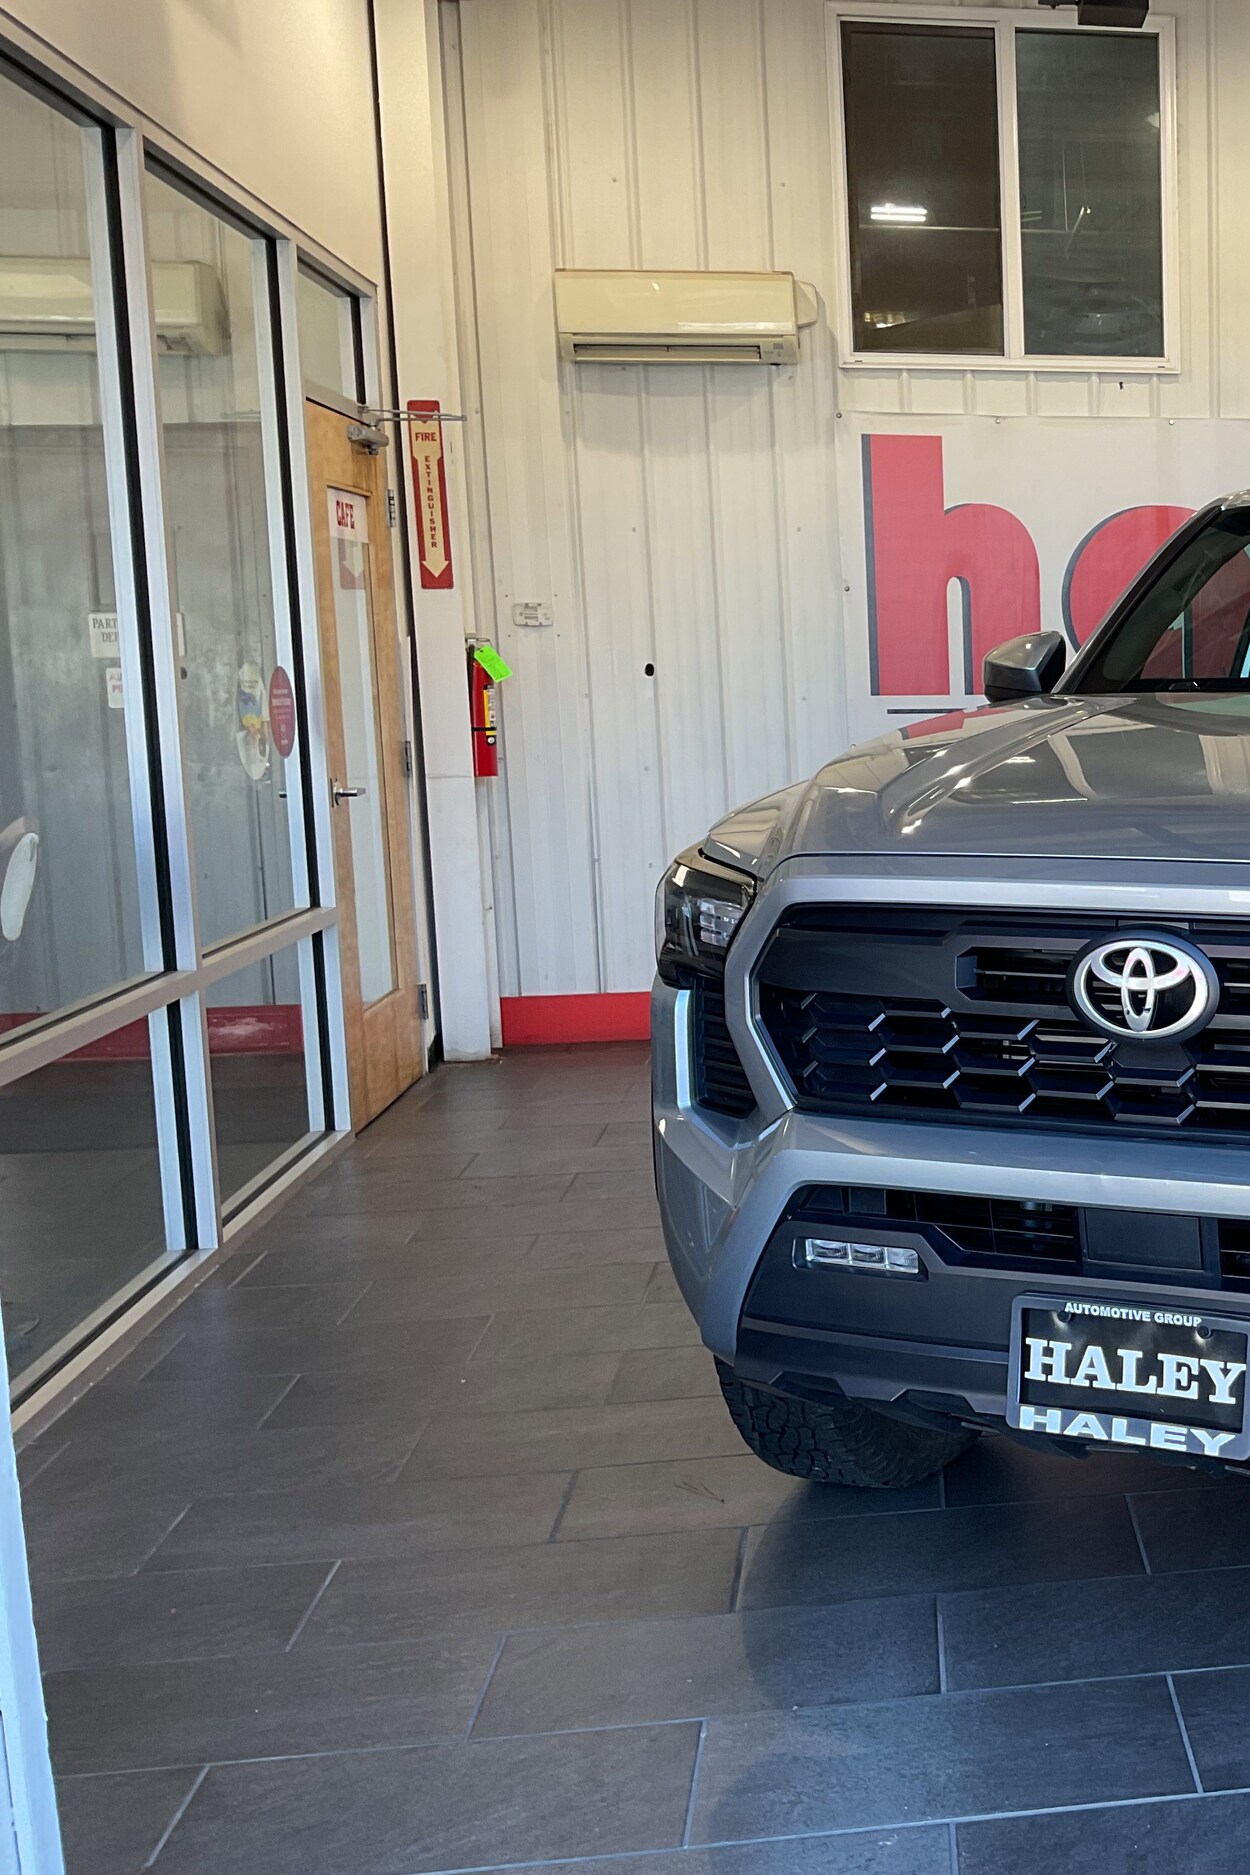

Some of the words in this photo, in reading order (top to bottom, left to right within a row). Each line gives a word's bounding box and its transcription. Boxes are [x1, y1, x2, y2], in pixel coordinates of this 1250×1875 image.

[415, 431, 438, 443] FIRE
[336, 499, 356, 530] CAFE
[424, 455, 438, 549] EXTINGUISHER
[92, 618, 118, 630] PART
[1065, 1302, 1151, 1322] AUTOMOTIVE
[1154, 1312, 1202, 1327] GROUP
[1024, 1337, 1247, 1405] HALEY
[1019, 1406, 1236, 1457] HALEY
